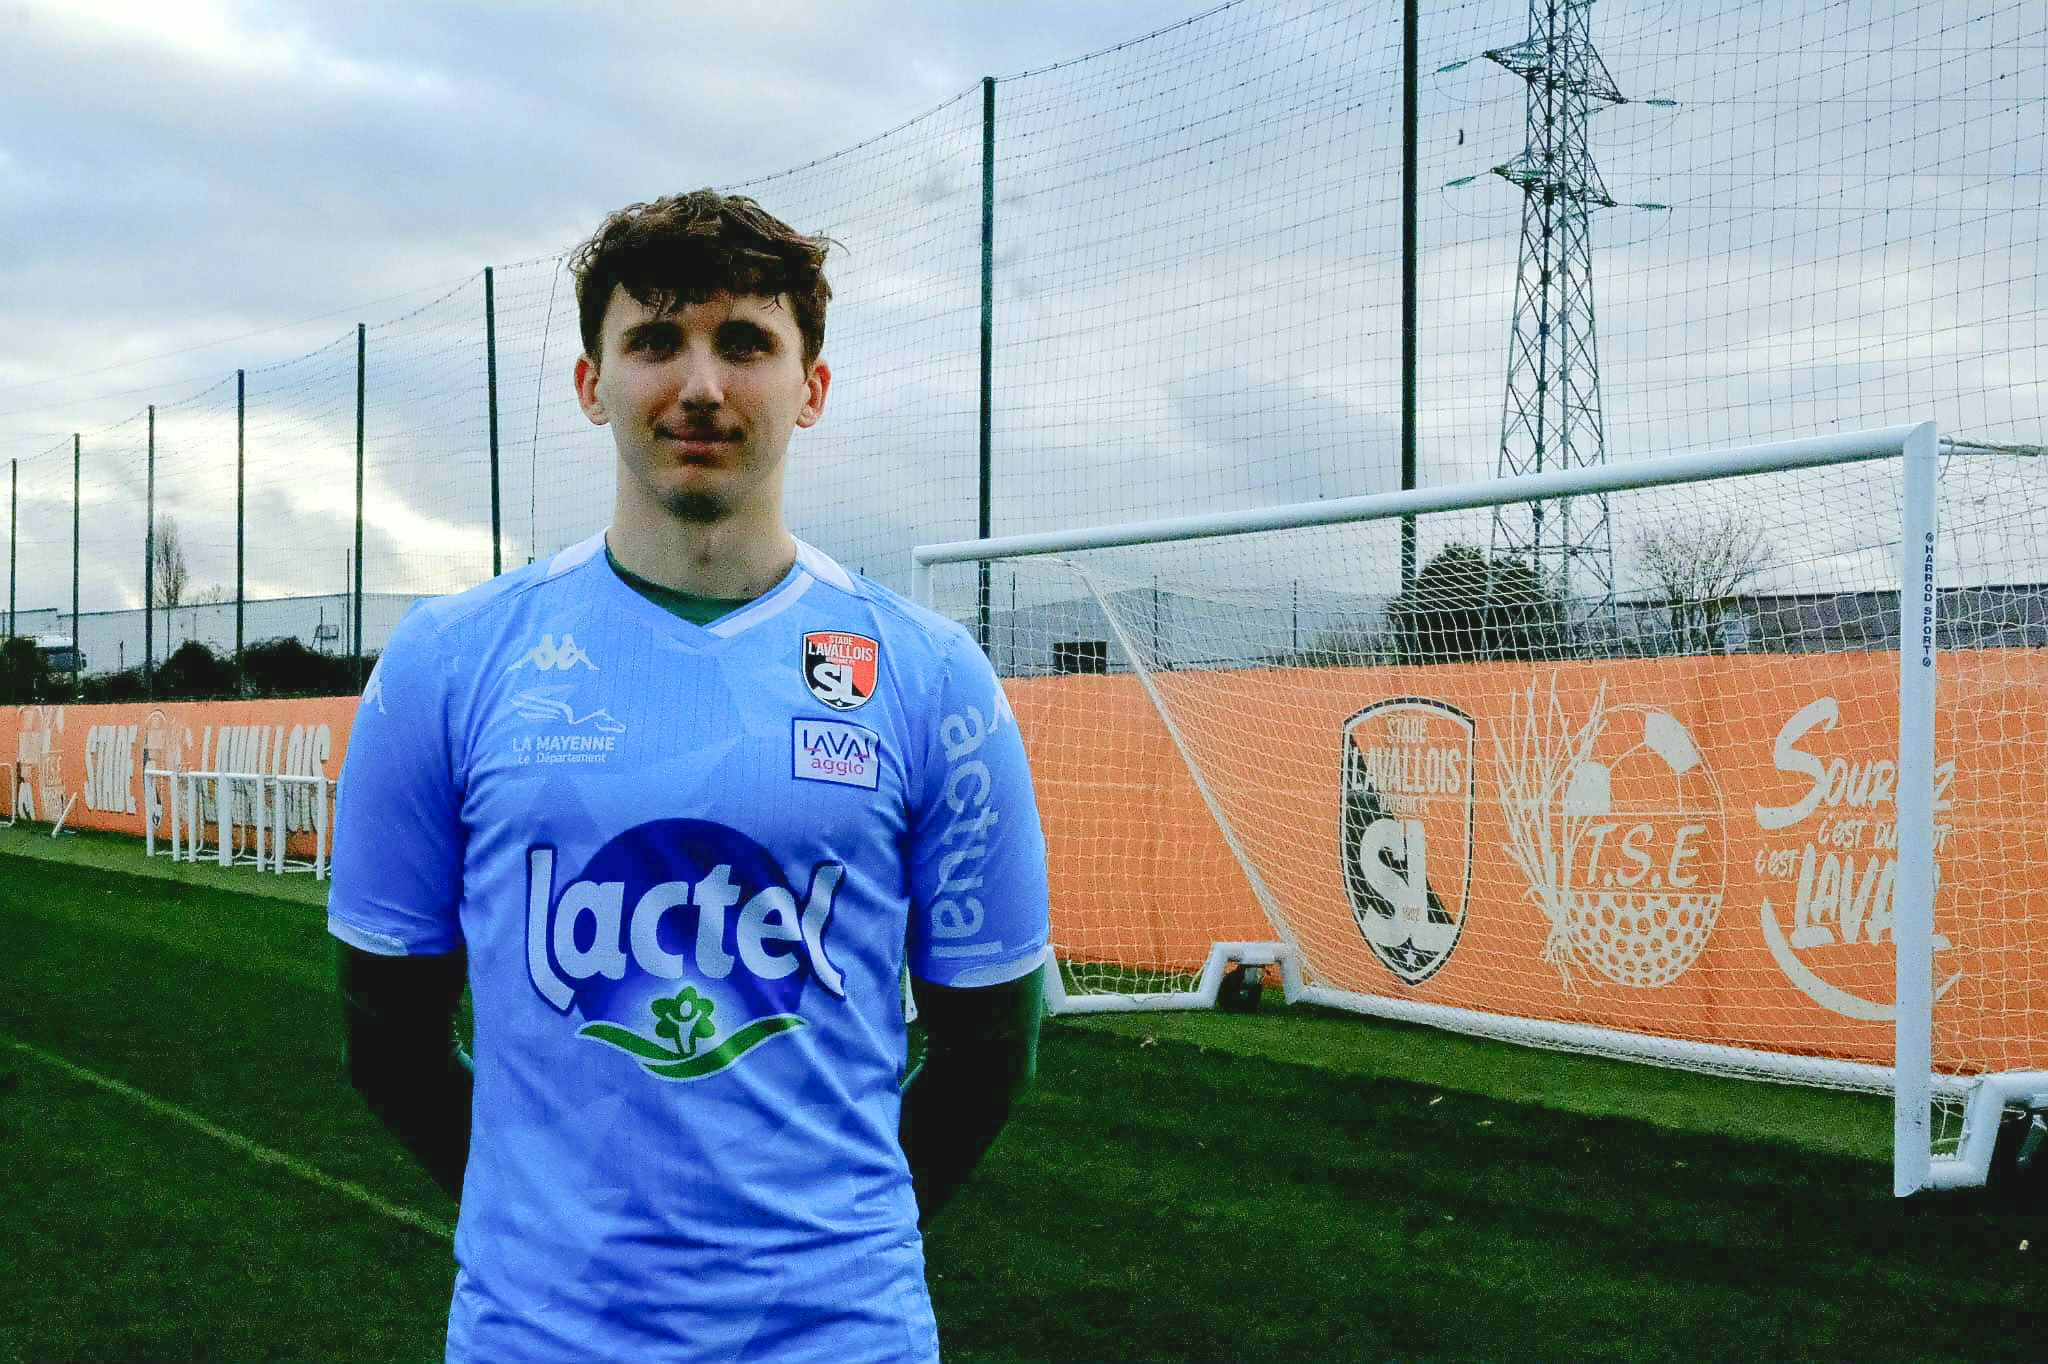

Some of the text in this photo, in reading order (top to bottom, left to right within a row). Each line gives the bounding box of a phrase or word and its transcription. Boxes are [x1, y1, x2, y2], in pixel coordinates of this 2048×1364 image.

[1923, 545, 1934, 655] HARROD SPORT
[808, 641, 873, 662] LAVALLOIS
[513, 735, 616, 752] LA MAYENNE
[518, 753, 530, 764] Le
[811, 758, 864, 776] agglo
[1352, 747, 1461, 794] LAVALLOIS
[930, 705, 1003, 958] actual
[526, 847, 846, 1013] lactel
